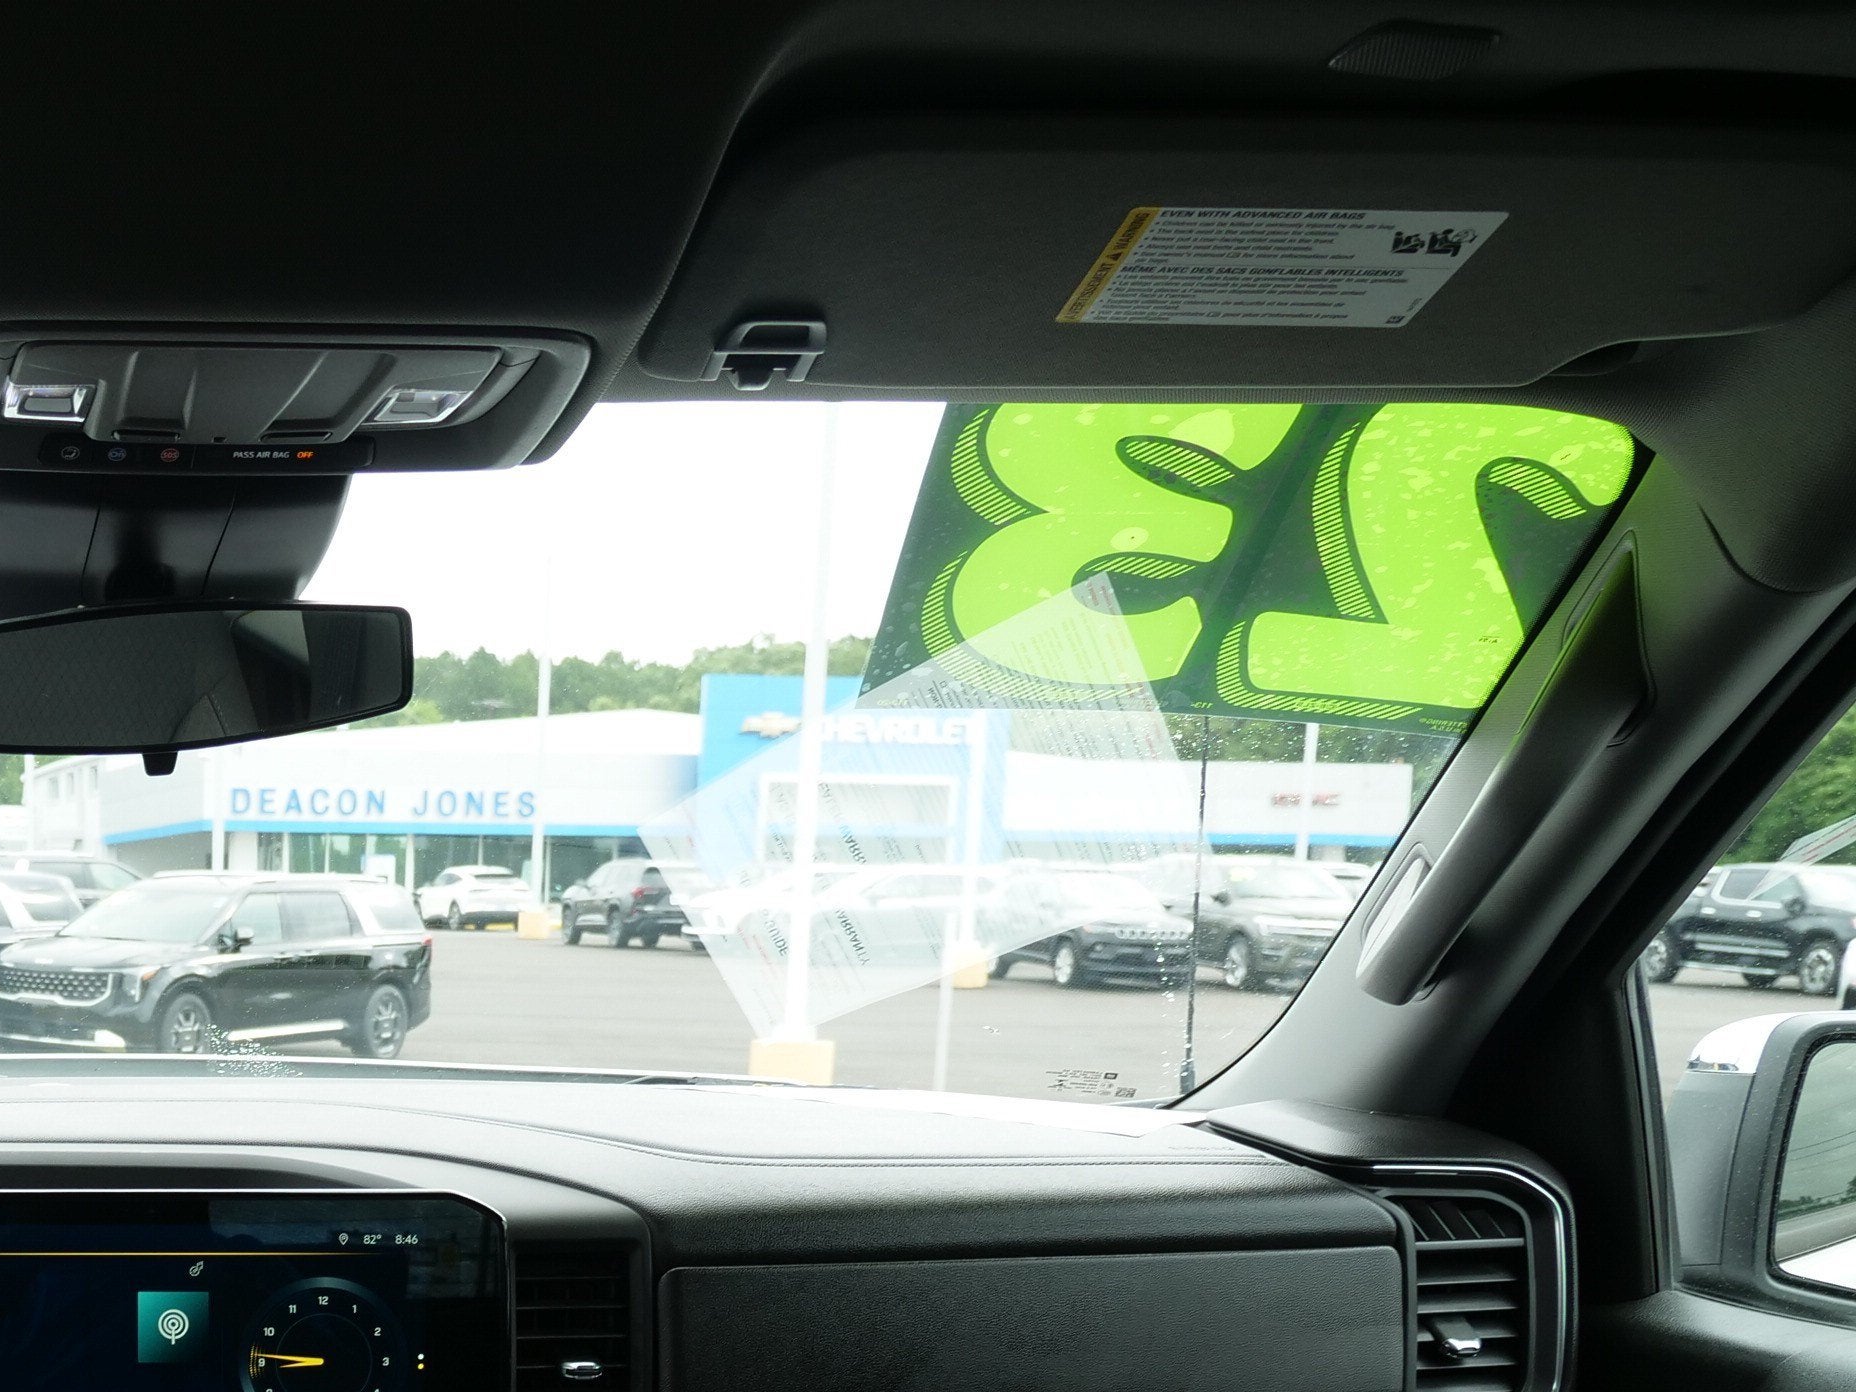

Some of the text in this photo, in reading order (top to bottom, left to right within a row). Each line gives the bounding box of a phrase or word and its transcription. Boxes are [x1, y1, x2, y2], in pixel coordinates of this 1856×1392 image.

[1249, 267, 1323, 276] GONFLABLES
[1325, 269, 1404, 277] INTELLIGENTS
[230, 787, 536, 817] DEACON JONES
[363, 1234, 418, 1245] 82° 8:46
[318, 1296, 328, 1305] 12
[289, 1305, 296, 1313] 11
[352, 1305, 357, 1313] 1
[263, 1327, 275, 1336] 10
[374, 1327, 381, 1336] 2
[258, 1358, 265, 1367] 9
[382, 1357, 390, 1366] 3
